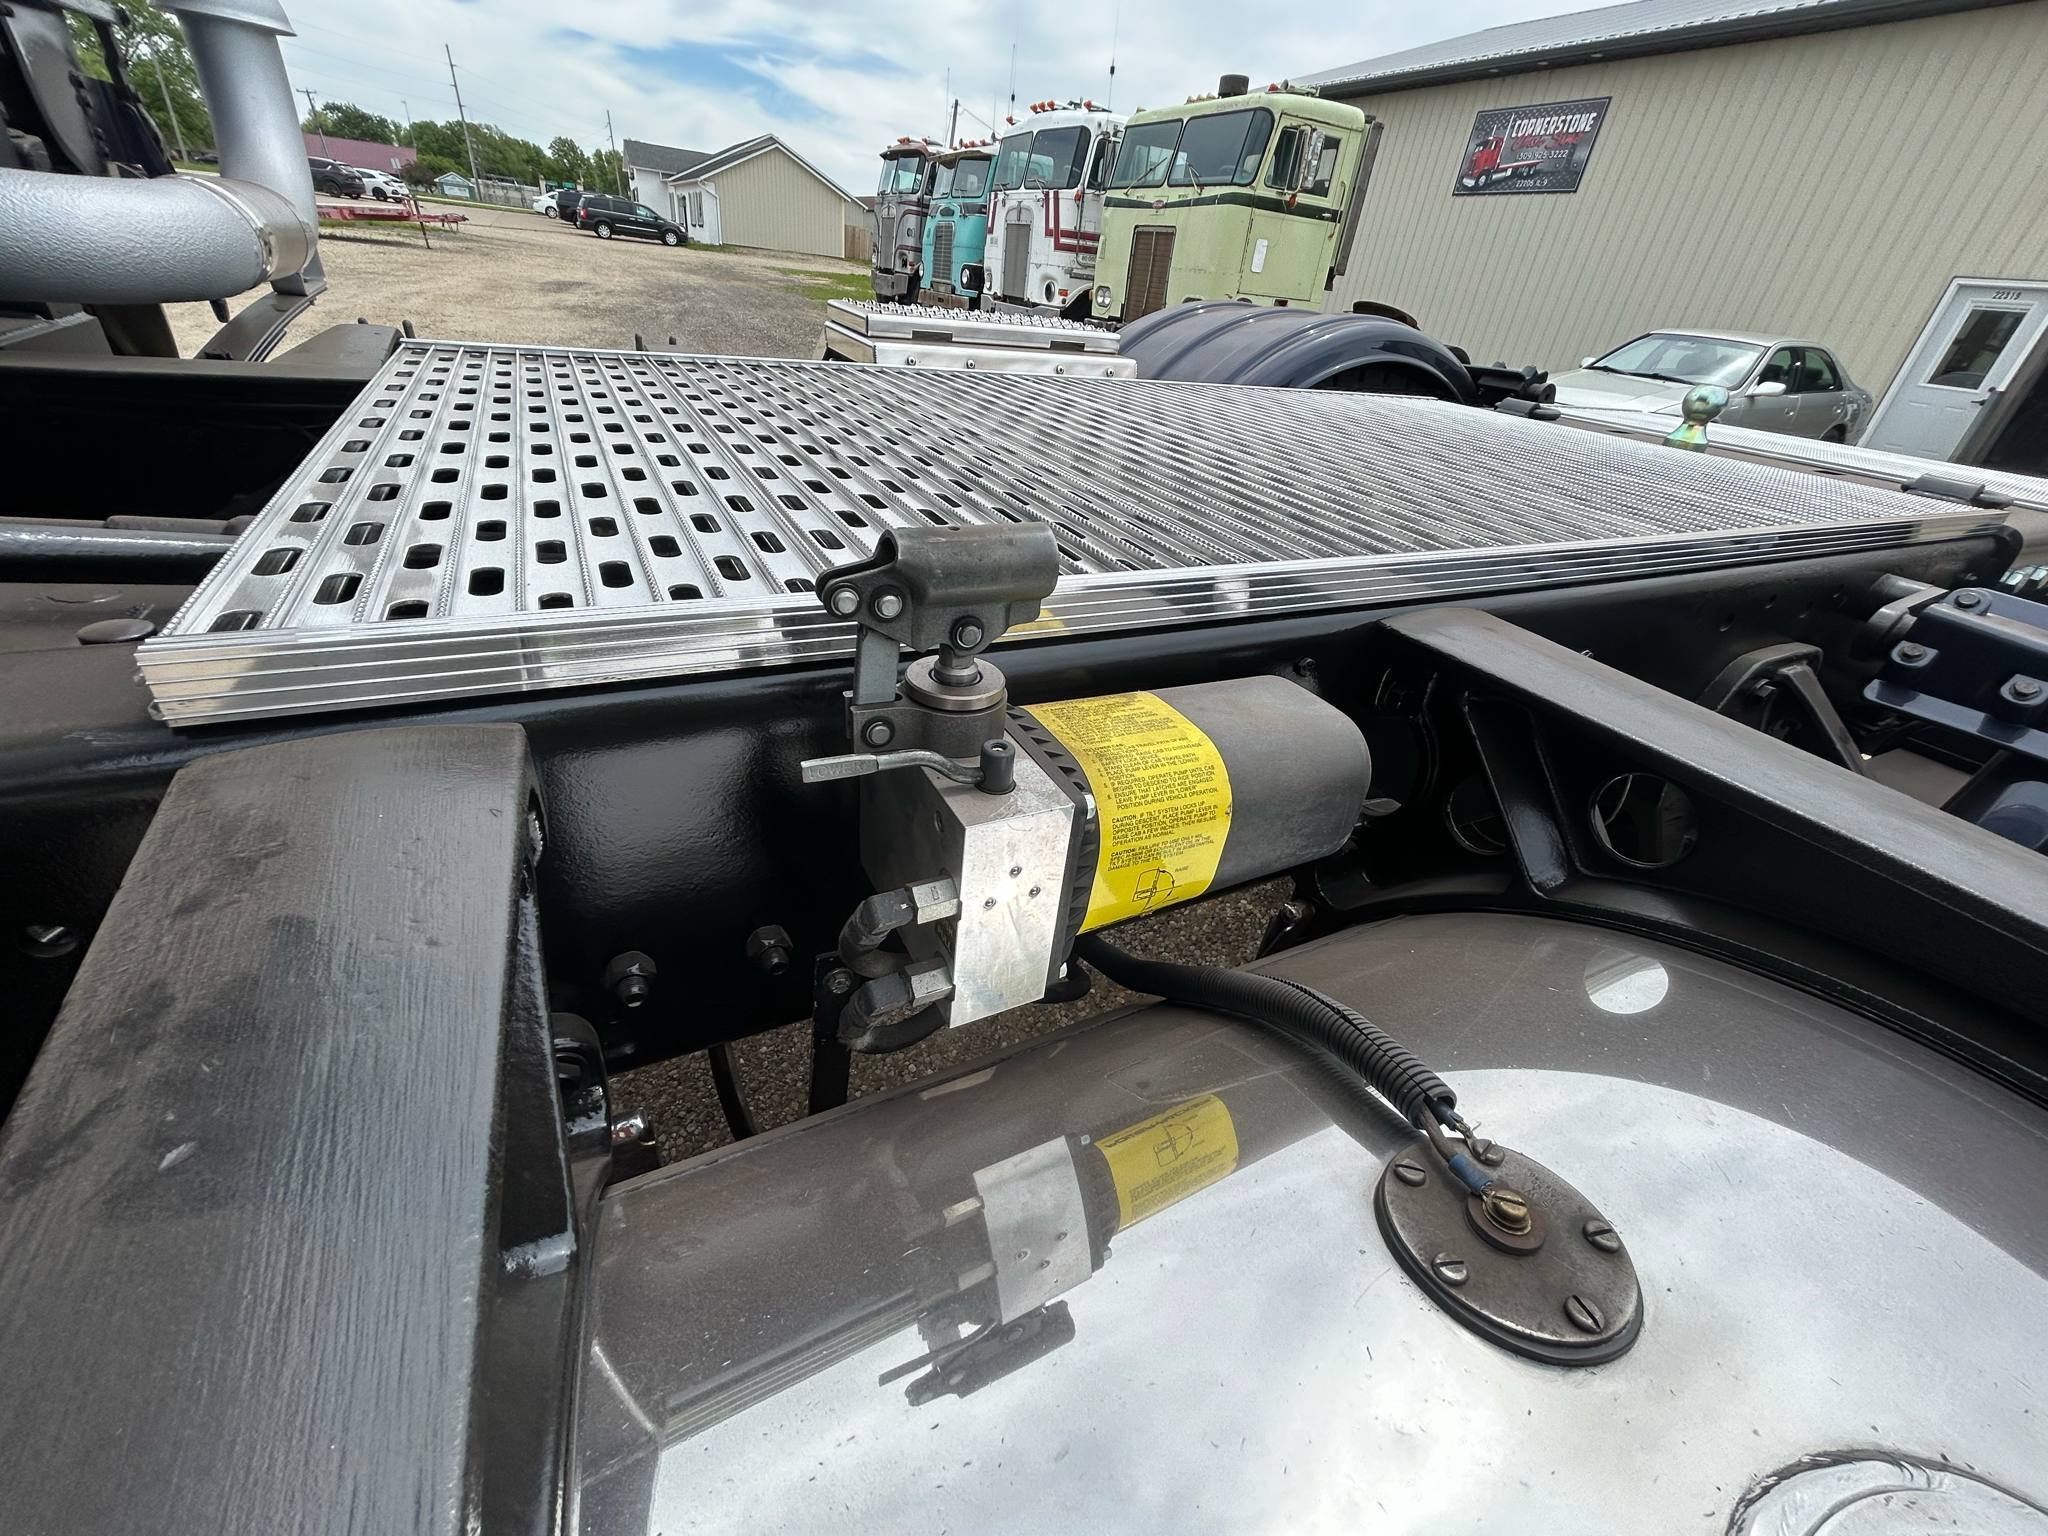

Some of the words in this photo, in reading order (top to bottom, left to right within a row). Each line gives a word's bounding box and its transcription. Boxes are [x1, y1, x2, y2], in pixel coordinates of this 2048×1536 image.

[1511, 112, 1597, 138] CORNERSTONE
[1117, 801, 1143, 810] POSITION
[1112, 821, 1134, 829] DURING
[1112, 826, 1139, 835] OPPOSITE
[1169, 815, 1192, 824] OPERATE
[1112, 837, 1143, 847] OPERATION
